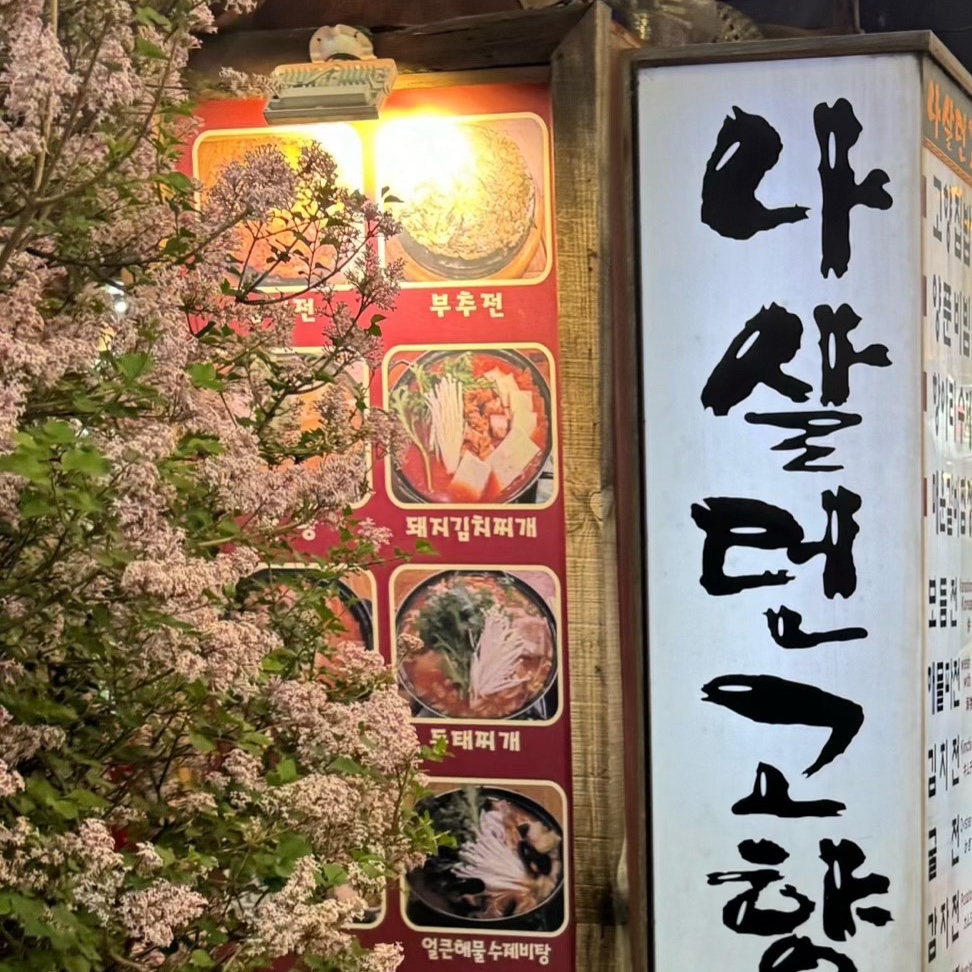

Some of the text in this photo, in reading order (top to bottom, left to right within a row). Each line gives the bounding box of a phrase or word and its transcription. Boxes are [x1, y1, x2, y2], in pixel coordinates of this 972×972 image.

[430, 290, 504, 318] 부추전
[406, 514, 537, 542] 돼지김치찌개
[927, 658, 961, 715] 해물파전
[928, 735, 960, 798] 김치전
[928, 890, 960, 963] 감자전
